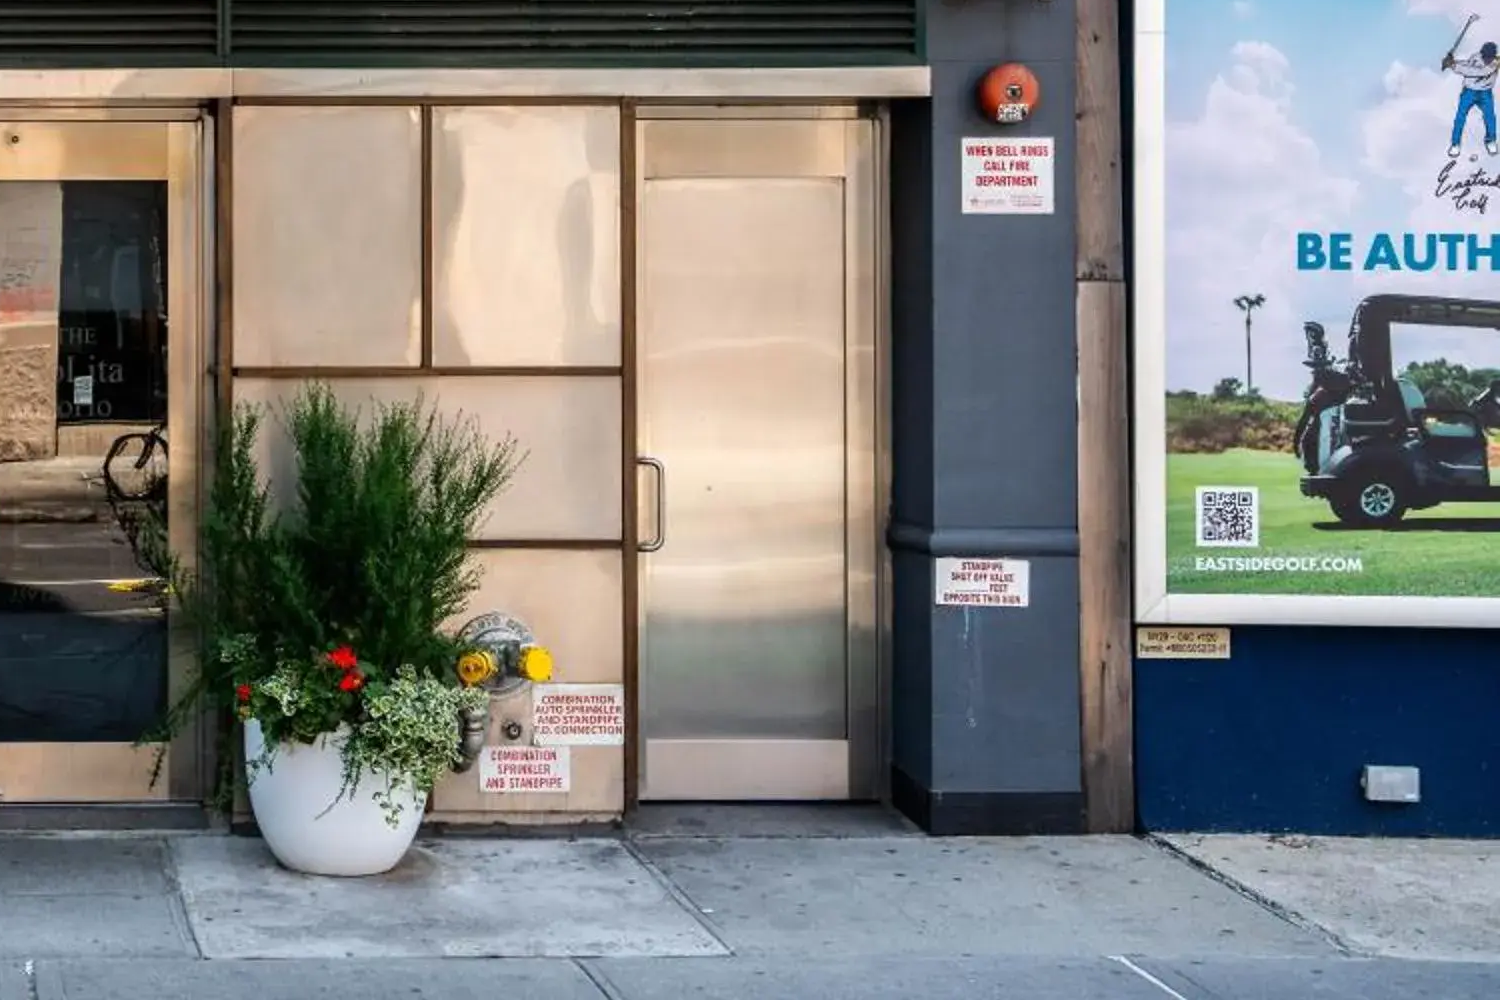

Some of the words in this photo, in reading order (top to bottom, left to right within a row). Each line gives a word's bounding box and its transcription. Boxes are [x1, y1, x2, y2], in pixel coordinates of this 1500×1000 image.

[966, 145, 993, 156] WHEN
[996, 145, 1019, 156] BELL
[1021, 145, 1049, 157] RINGS
[983, 160, 1006, 171] CALL
[1009, 160, 1030, 171] FIRE
[975, 175, 1039, 187] DEPARTMENT
[1297, 232, 1352, 271] BE
[1363, 232, 1500, 271] AUTH
[1195, 557, 1363, 573] EASTSIDEGOLF.COM
[541, 695, 615, 705] COMBINATION
[535, 705, 563, 714] AUTO
[565, 705, 622, 715] SPRINKLER
[537, 715, 561, 725] AND
[554, 725, 623, 735] CONNECTION
[491, 749, 557, 761] COMBINATION
[497, 763, 551, 775] SPRINKLER
[485, 777, 505, 789] AND
[509, 777, 563, 789] STANDPIPE
